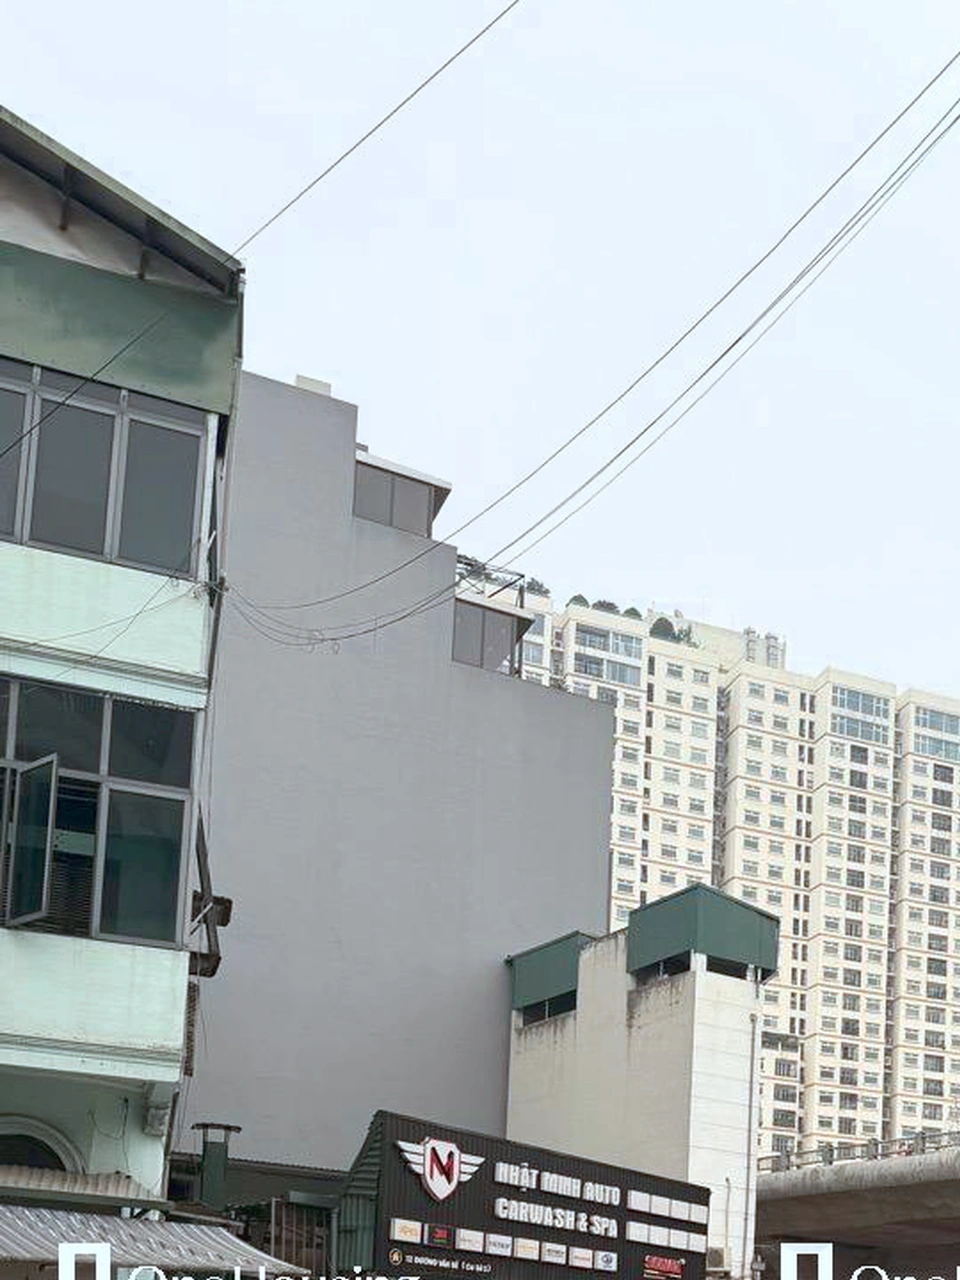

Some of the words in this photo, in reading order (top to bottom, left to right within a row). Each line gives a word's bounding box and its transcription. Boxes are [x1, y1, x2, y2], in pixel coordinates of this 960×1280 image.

[494, 1162, 539, 1193] NHẬT
[540, 1171, 582, 1199] MINH
[583, 1182, 621, 1207] AUTO
[495, 1197, 576, 1231] CARWASH
[577, 1211, 588, 1233] &
[589, 1214, 618, 1239] SPA
